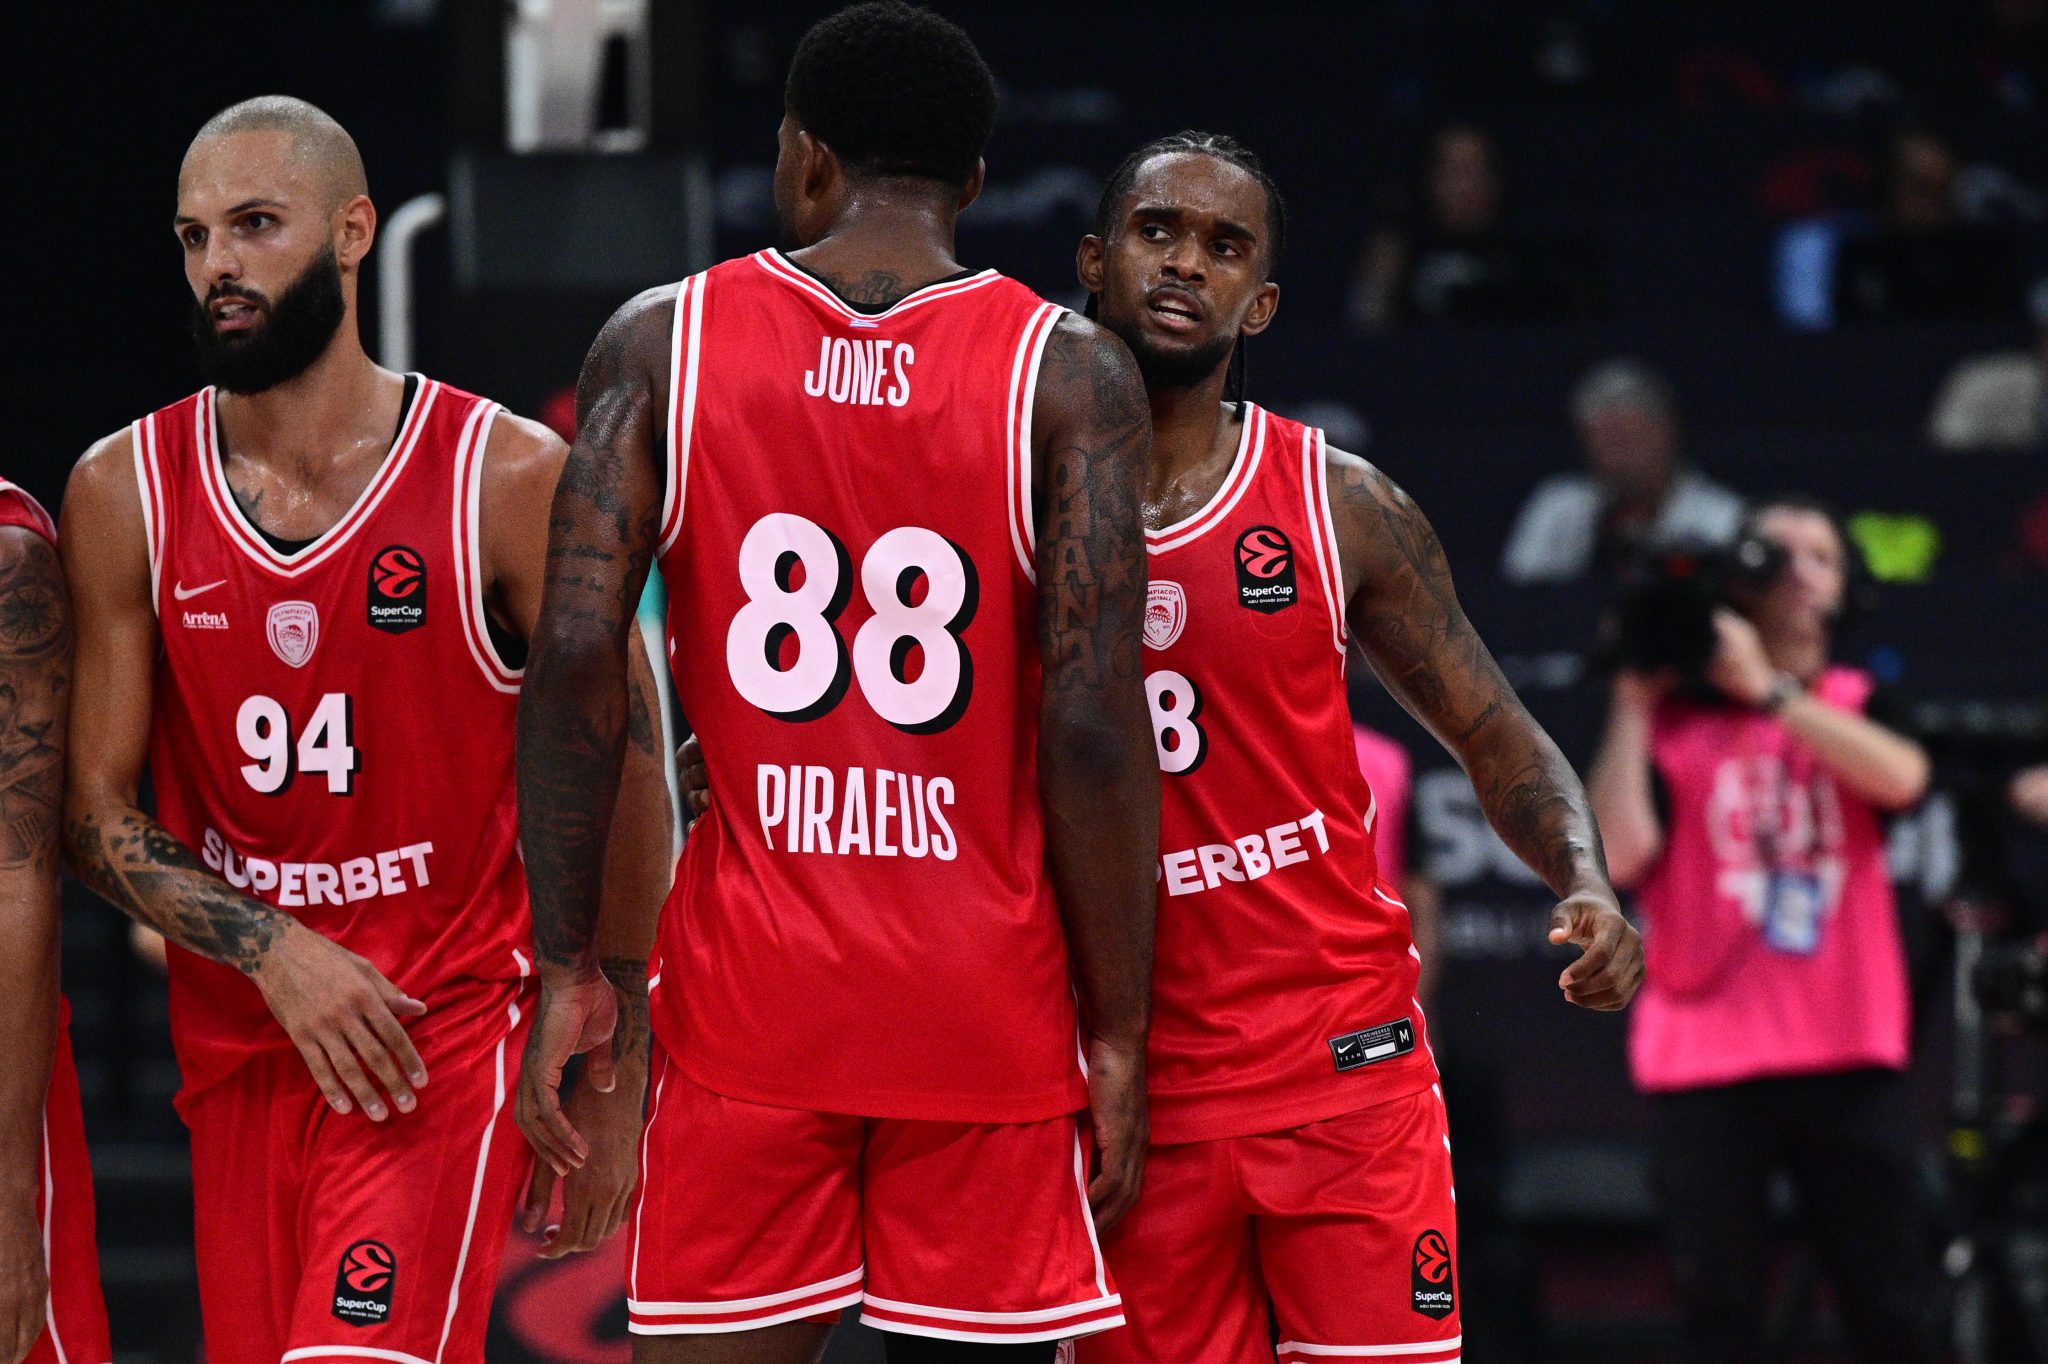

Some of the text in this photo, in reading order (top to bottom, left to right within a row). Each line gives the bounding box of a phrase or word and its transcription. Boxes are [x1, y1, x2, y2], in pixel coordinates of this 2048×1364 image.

[804, 336, 914, 407] JONES
[371, 605, 422, 617] SuperCup
[727, 512, 976, 731] 88
[1242, 585, 1293, 597] SuperCup
[236, 692, 358, 795] 94
[1145, 670, 1206, 775] 8
[757, 763, 958, 861] PIRAEUS
[202, 827, 433, 907] SUPERBET
[1156, 808, 1330, 897] ERBET
[1339, 1052, 1361, 1062] TEAM
[1399, 1028, 1410, 1043] M
[336, 1296, 387, 1313] SuperCup
[1415, 1291, 1452, 1303] SuperCup
